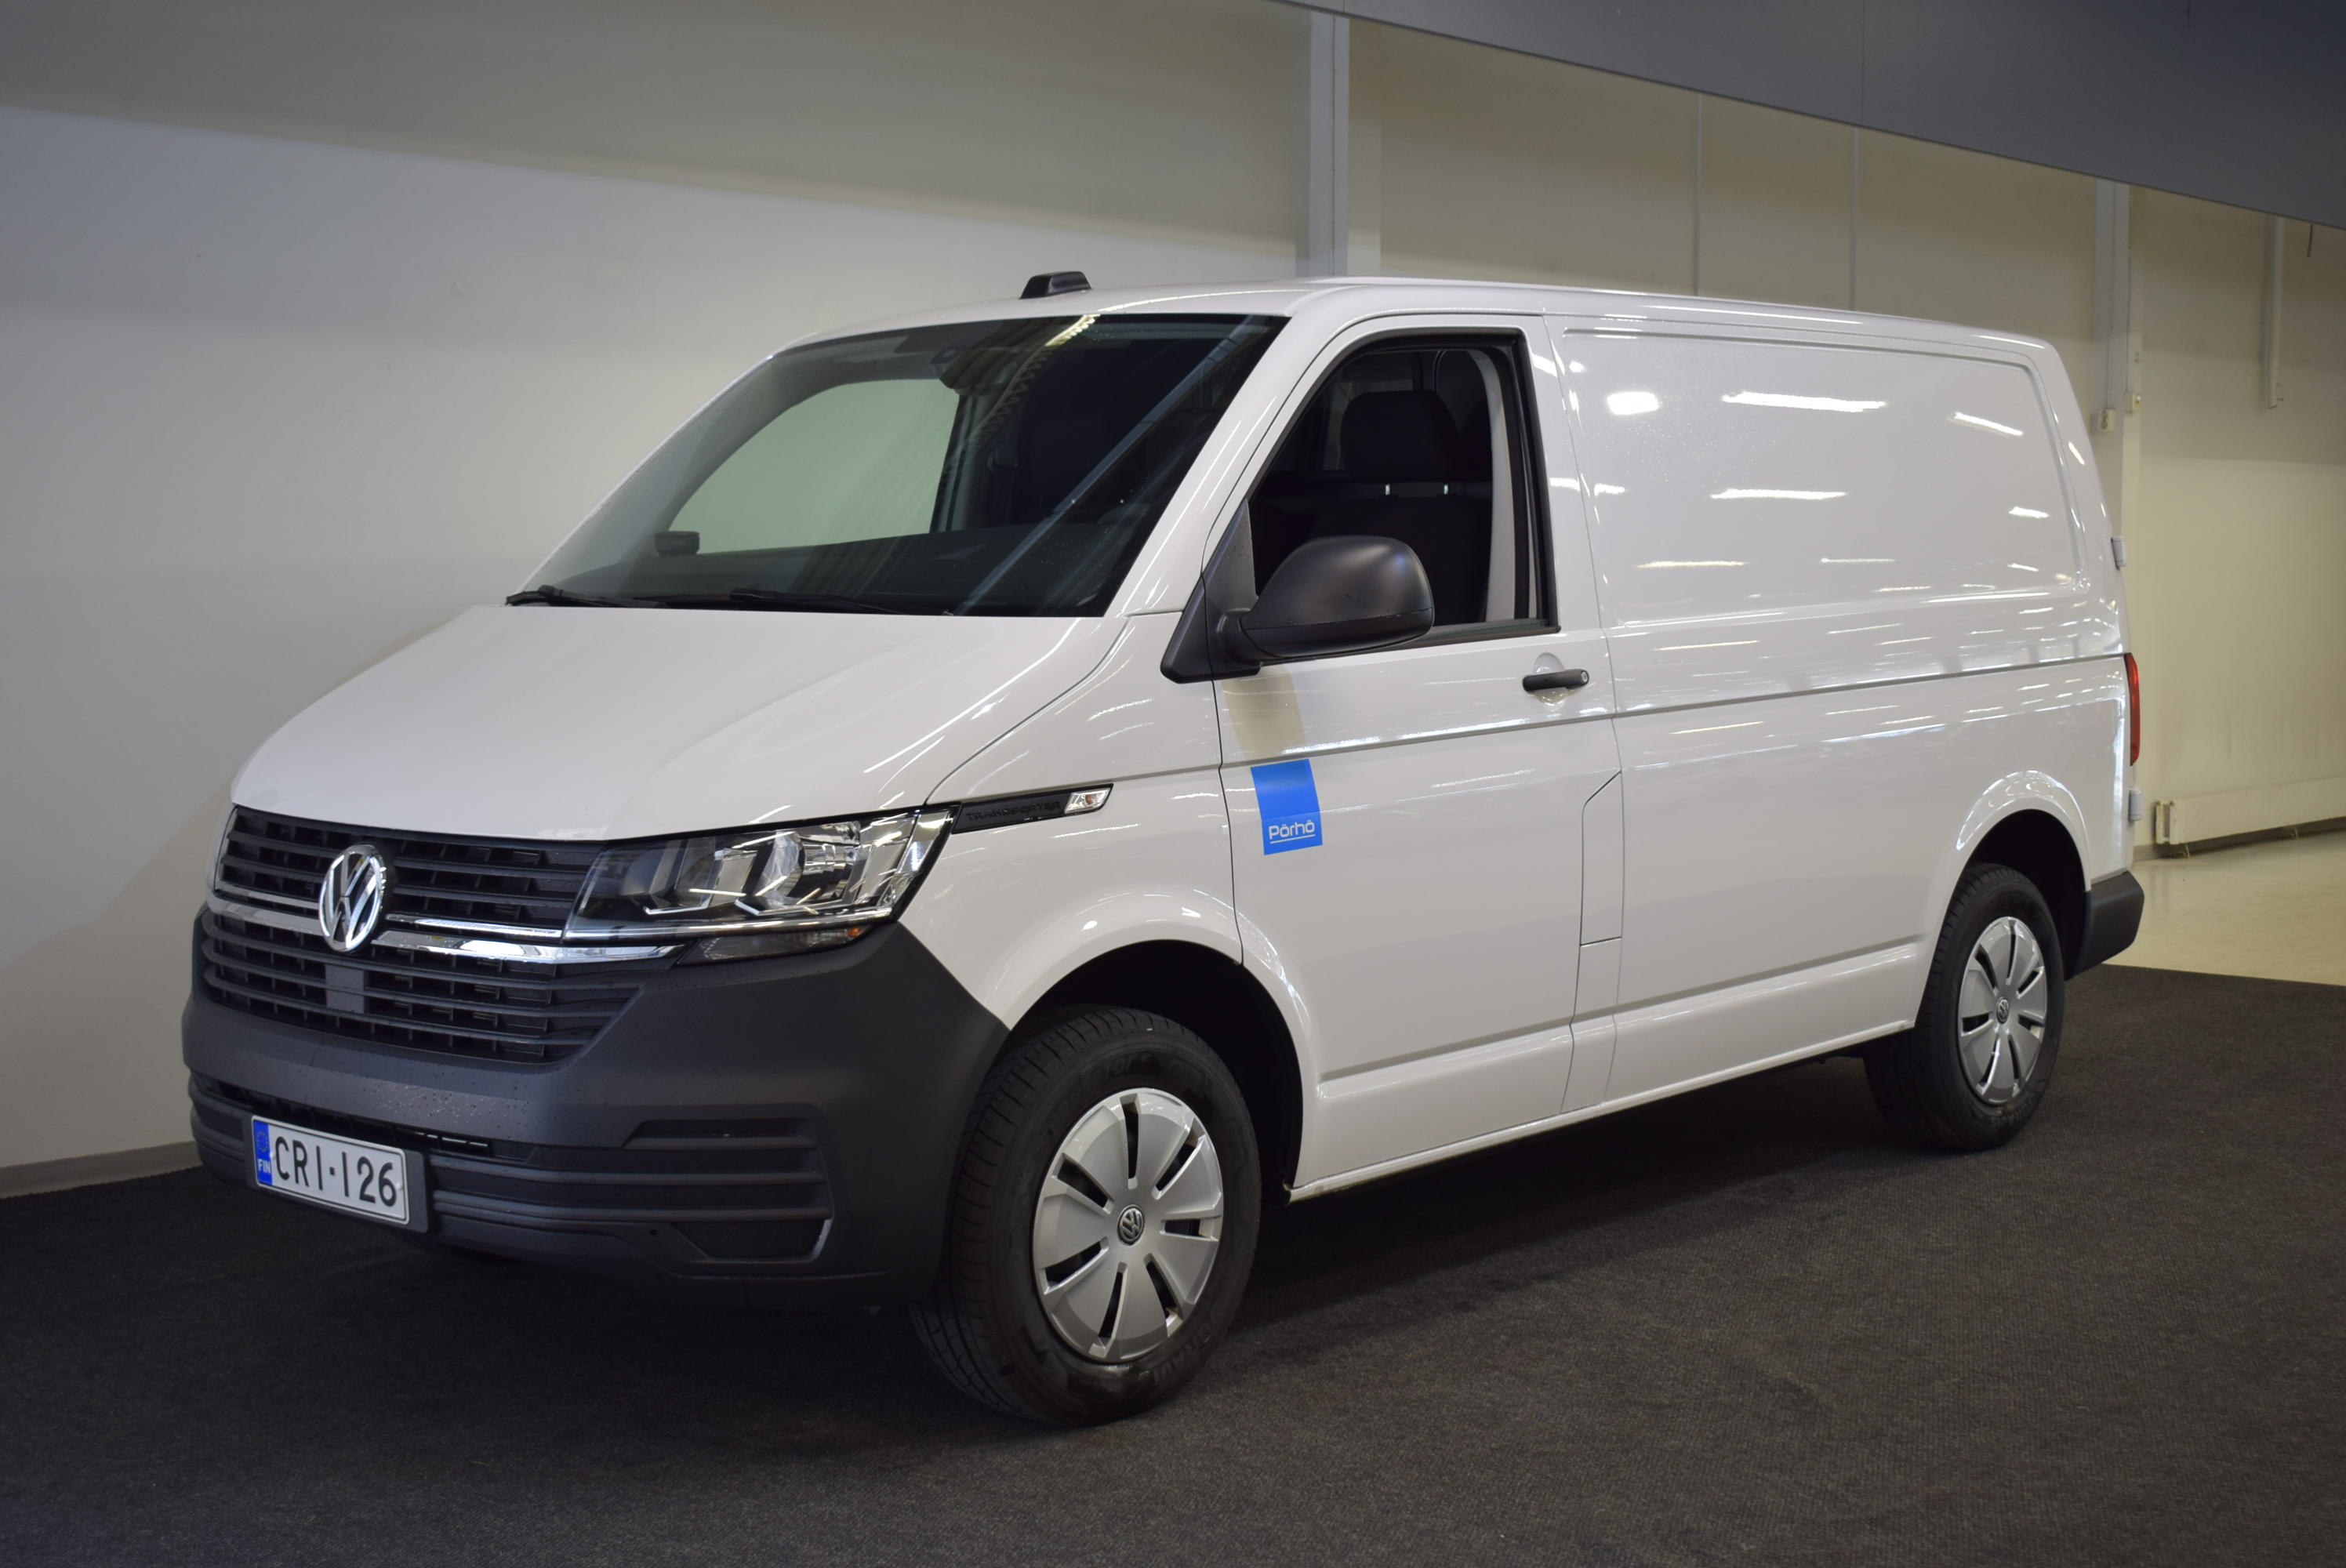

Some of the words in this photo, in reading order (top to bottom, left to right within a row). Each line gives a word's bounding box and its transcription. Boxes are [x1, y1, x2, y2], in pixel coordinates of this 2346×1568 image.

[966, 801, 1062, 821] TRANSPORTER
[1269, 819, 1315, 840] Pörhö
[258, 1158, 271, 1175] FIN
[274, 1135, 398, 1207] CRI-126
